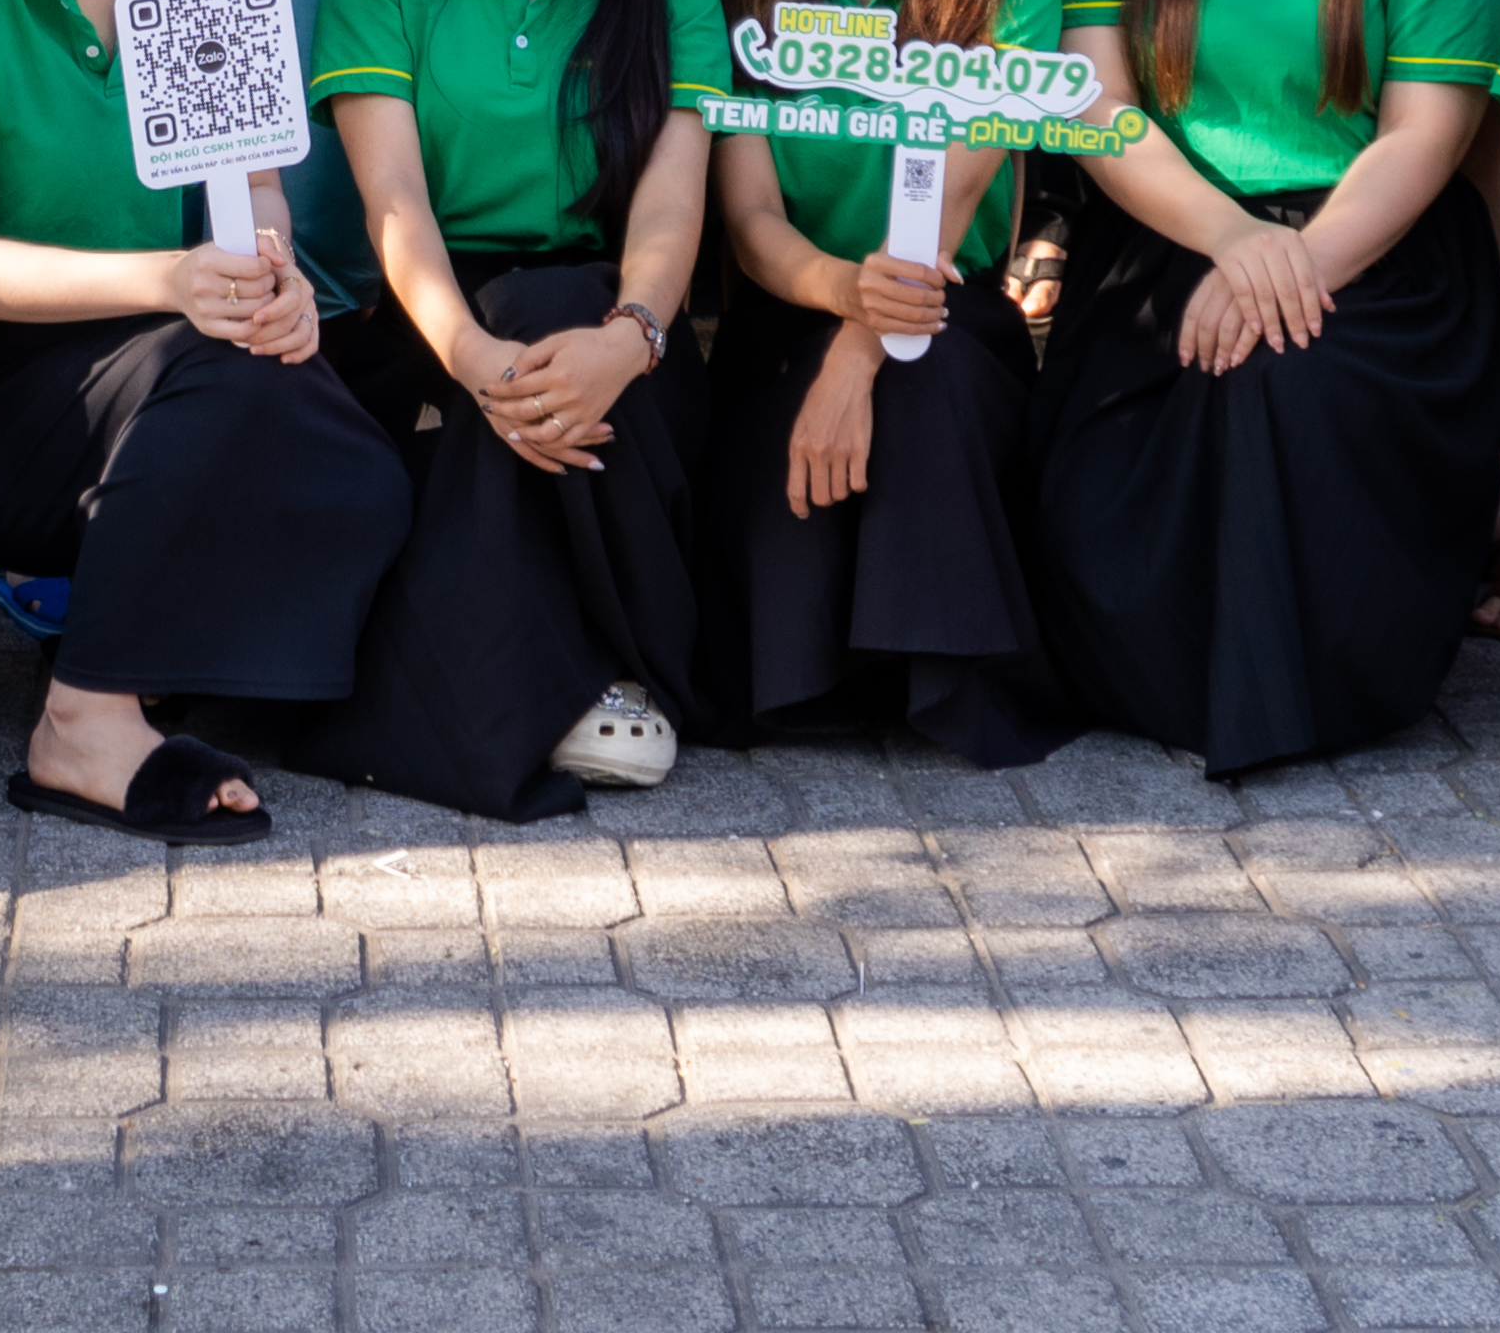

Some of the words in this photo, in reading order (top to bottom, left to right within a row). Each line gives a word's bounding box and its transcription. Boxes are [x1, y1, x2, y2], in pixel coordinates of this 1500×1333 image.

[780, 8, 890, 39] HOTLINE
[197, 49, 225, 65] Zalo
[778, 39, 1089, 97] 0328.204.079
[704, 100, 768, 129] TEM
[779, 96, 839, 135] DÁN
[850, 103, 896, 139] GIÁ
[1043, 121, 1121, 152] thien
[150, 149, 172, 165] ĐỘI
[176, 143, 199, 159] NGŨ
[203, 141, 234, 155] CSKH
[238, 134, 268, 151] TRỰC
[271, 129, 296, 143] 24/7
